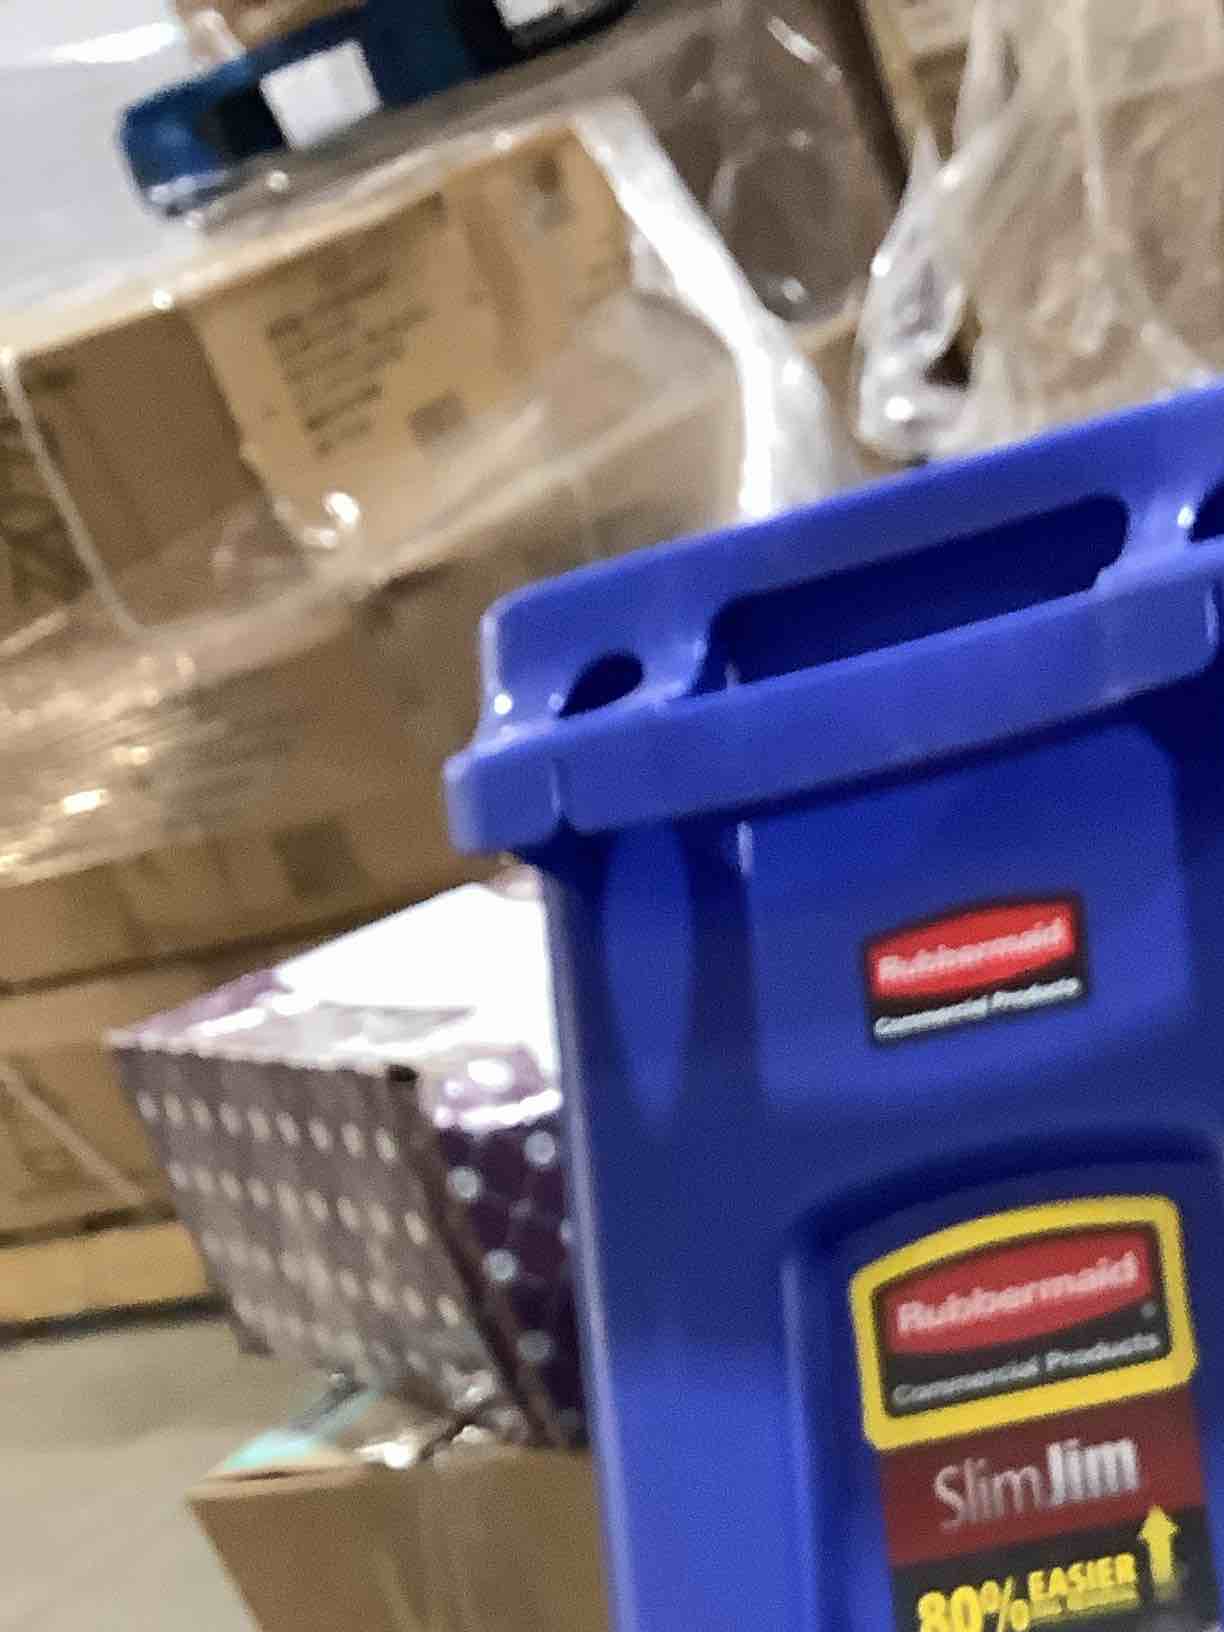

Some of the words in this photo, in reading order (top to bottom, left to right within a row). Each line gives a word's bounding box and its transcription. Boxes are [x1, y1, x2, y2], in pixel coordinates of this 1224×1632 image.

[877, 916, 1067, 986] Rubbermaid
[896, 1250, 1138, 1333] Rubbermaid
[893, 1354, 1041, 1405] Commercial
